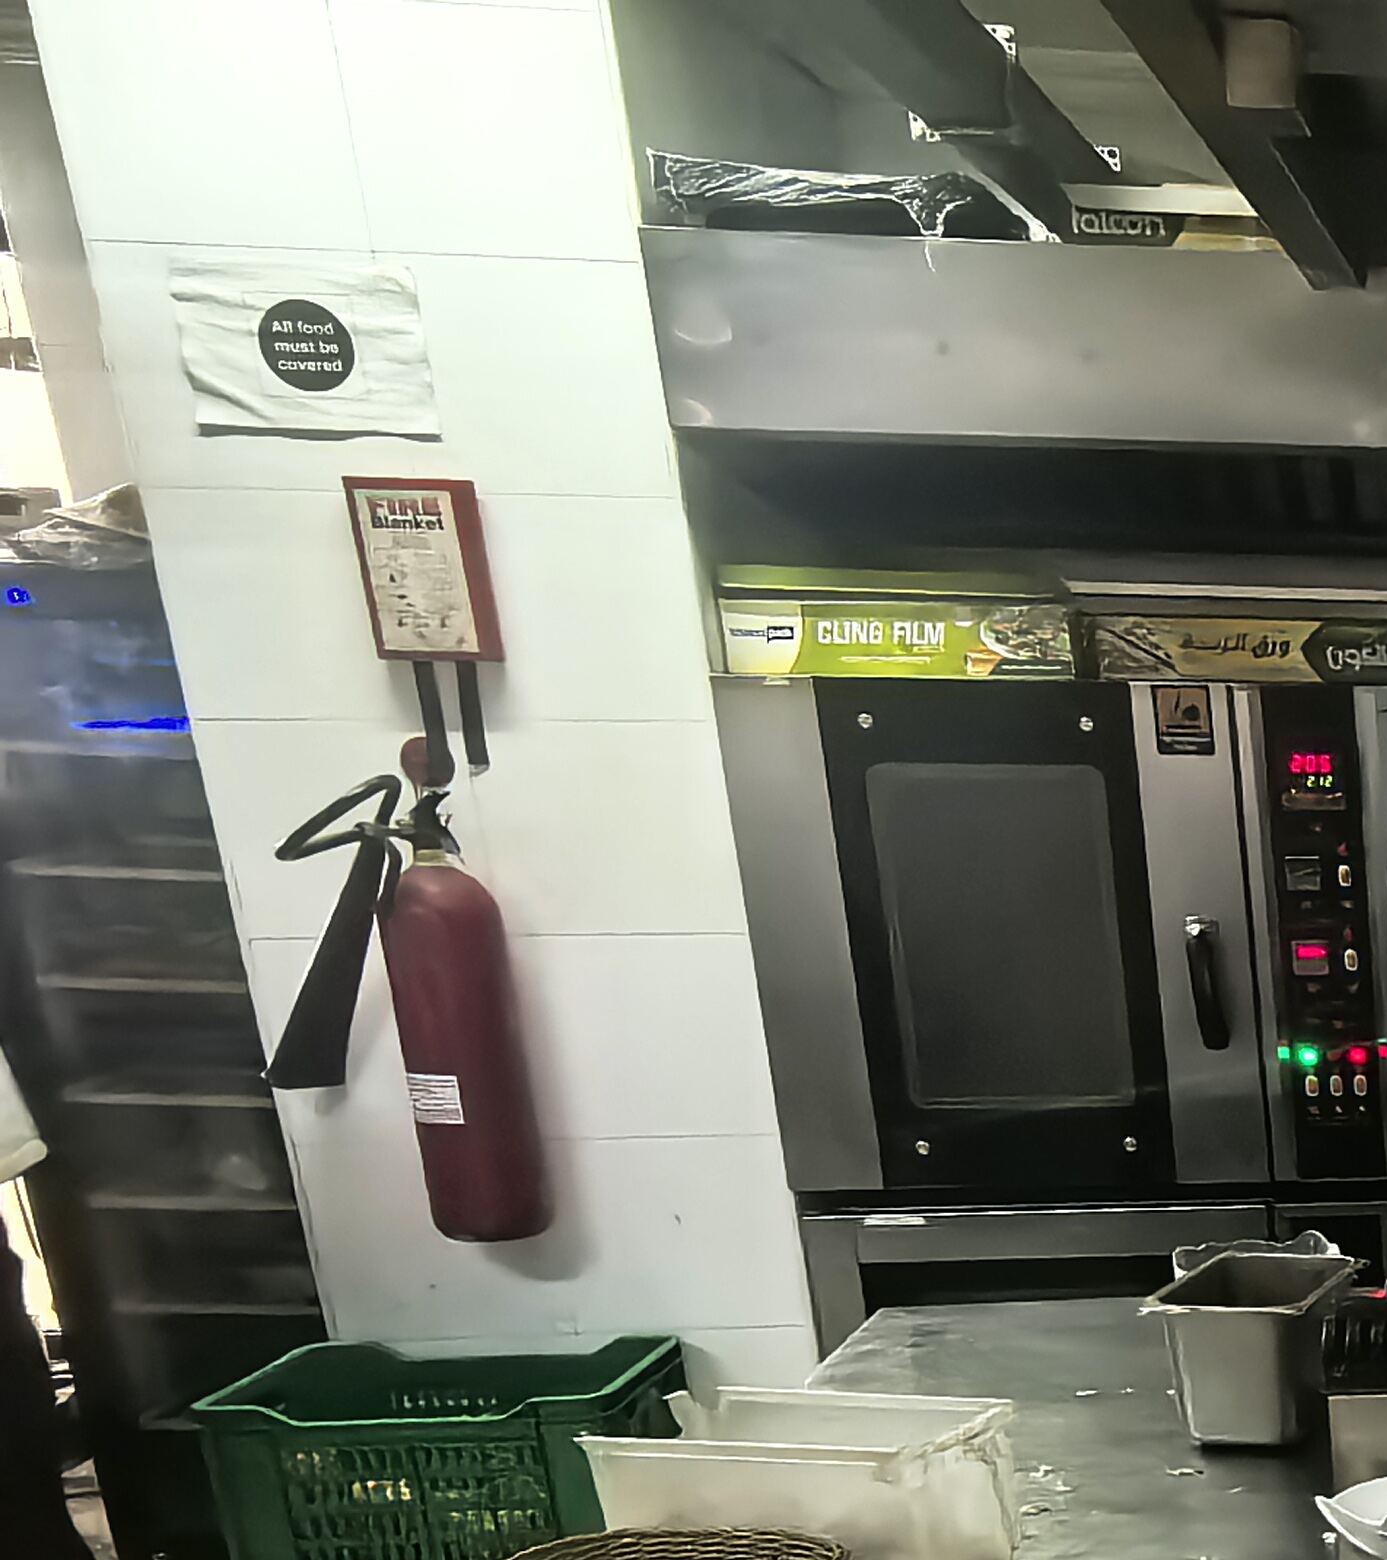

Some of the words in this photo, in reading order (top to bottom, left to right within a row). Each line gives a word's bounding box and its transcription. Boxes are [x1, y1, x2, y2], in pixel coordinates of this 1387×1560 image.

[272, 320, 293, 333] All
[297, 320, 334, 335] food
[274, 342, 316, 353] must
[319, 340, 339, 354] be
[278, 359, 344, 371] covered
[817, 620, 884, 645] CLING
[893, 620, 945, 646] FILM
